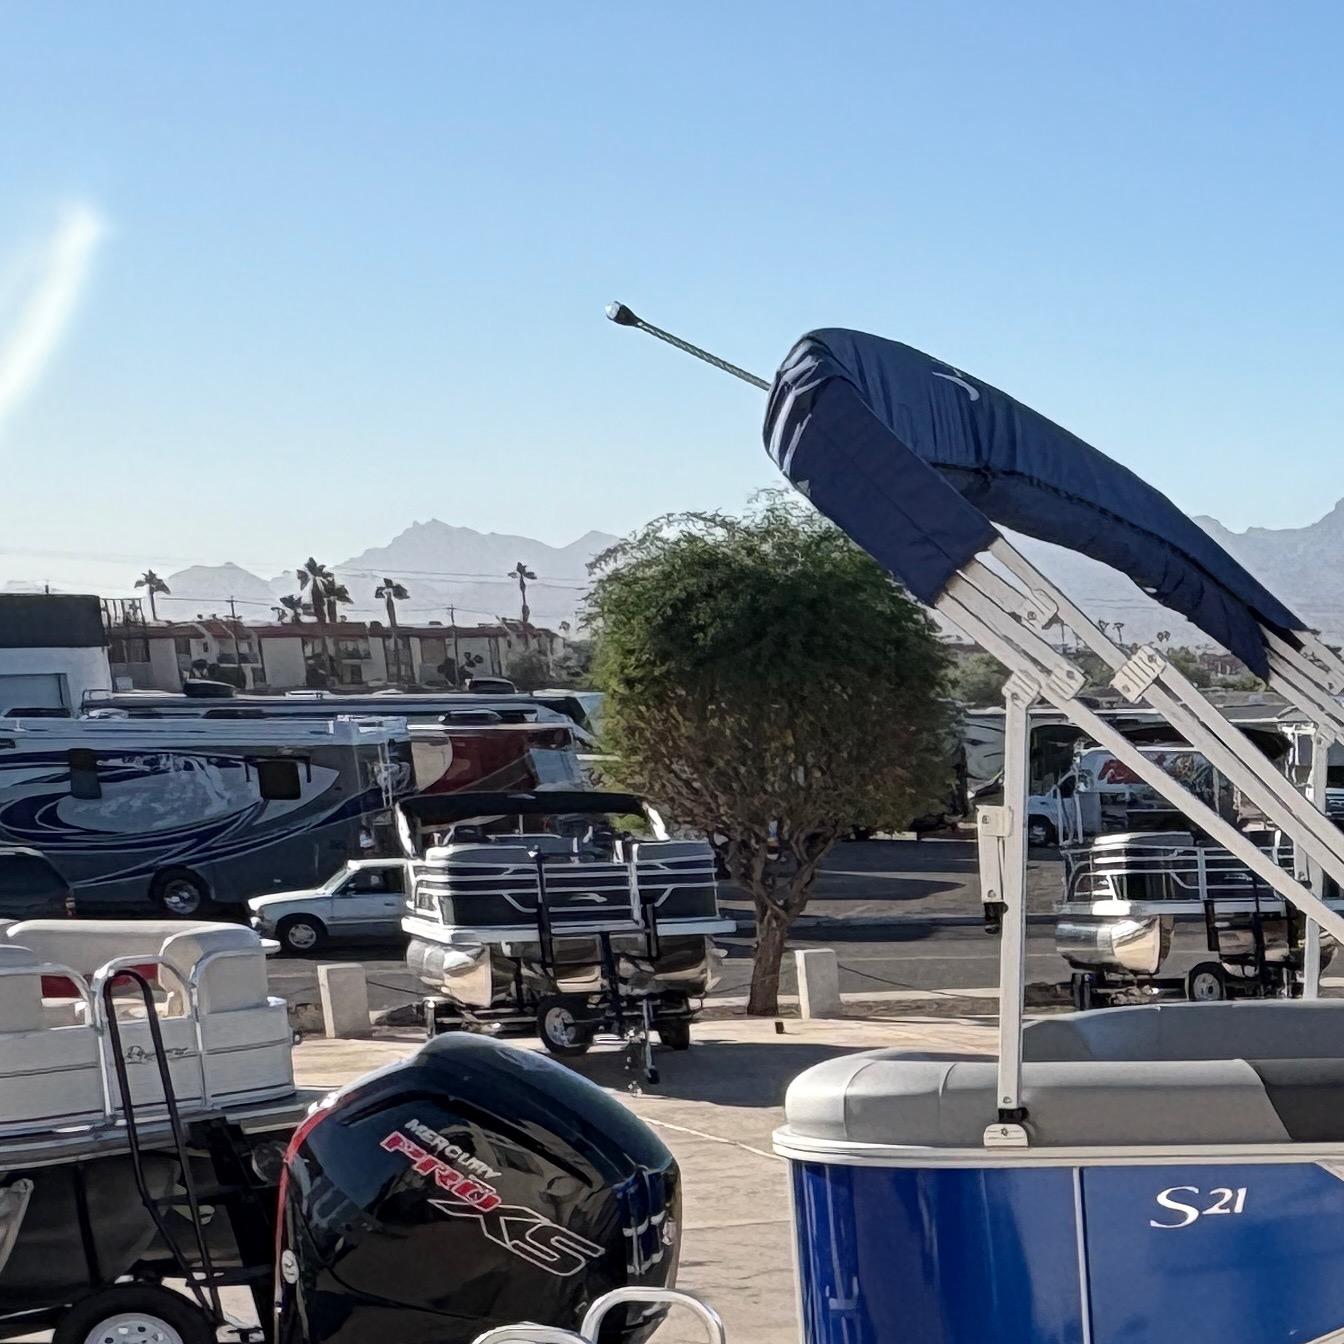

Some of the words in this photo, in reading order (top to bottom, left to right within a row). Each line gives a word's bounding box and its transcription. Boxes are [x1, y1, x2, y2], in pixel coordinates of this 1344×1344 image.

[379, 1130, 502, 1213] PRO
[404, 1118, 502, 1180] MERCURY
[427, 1174, 605, 1277] XS
